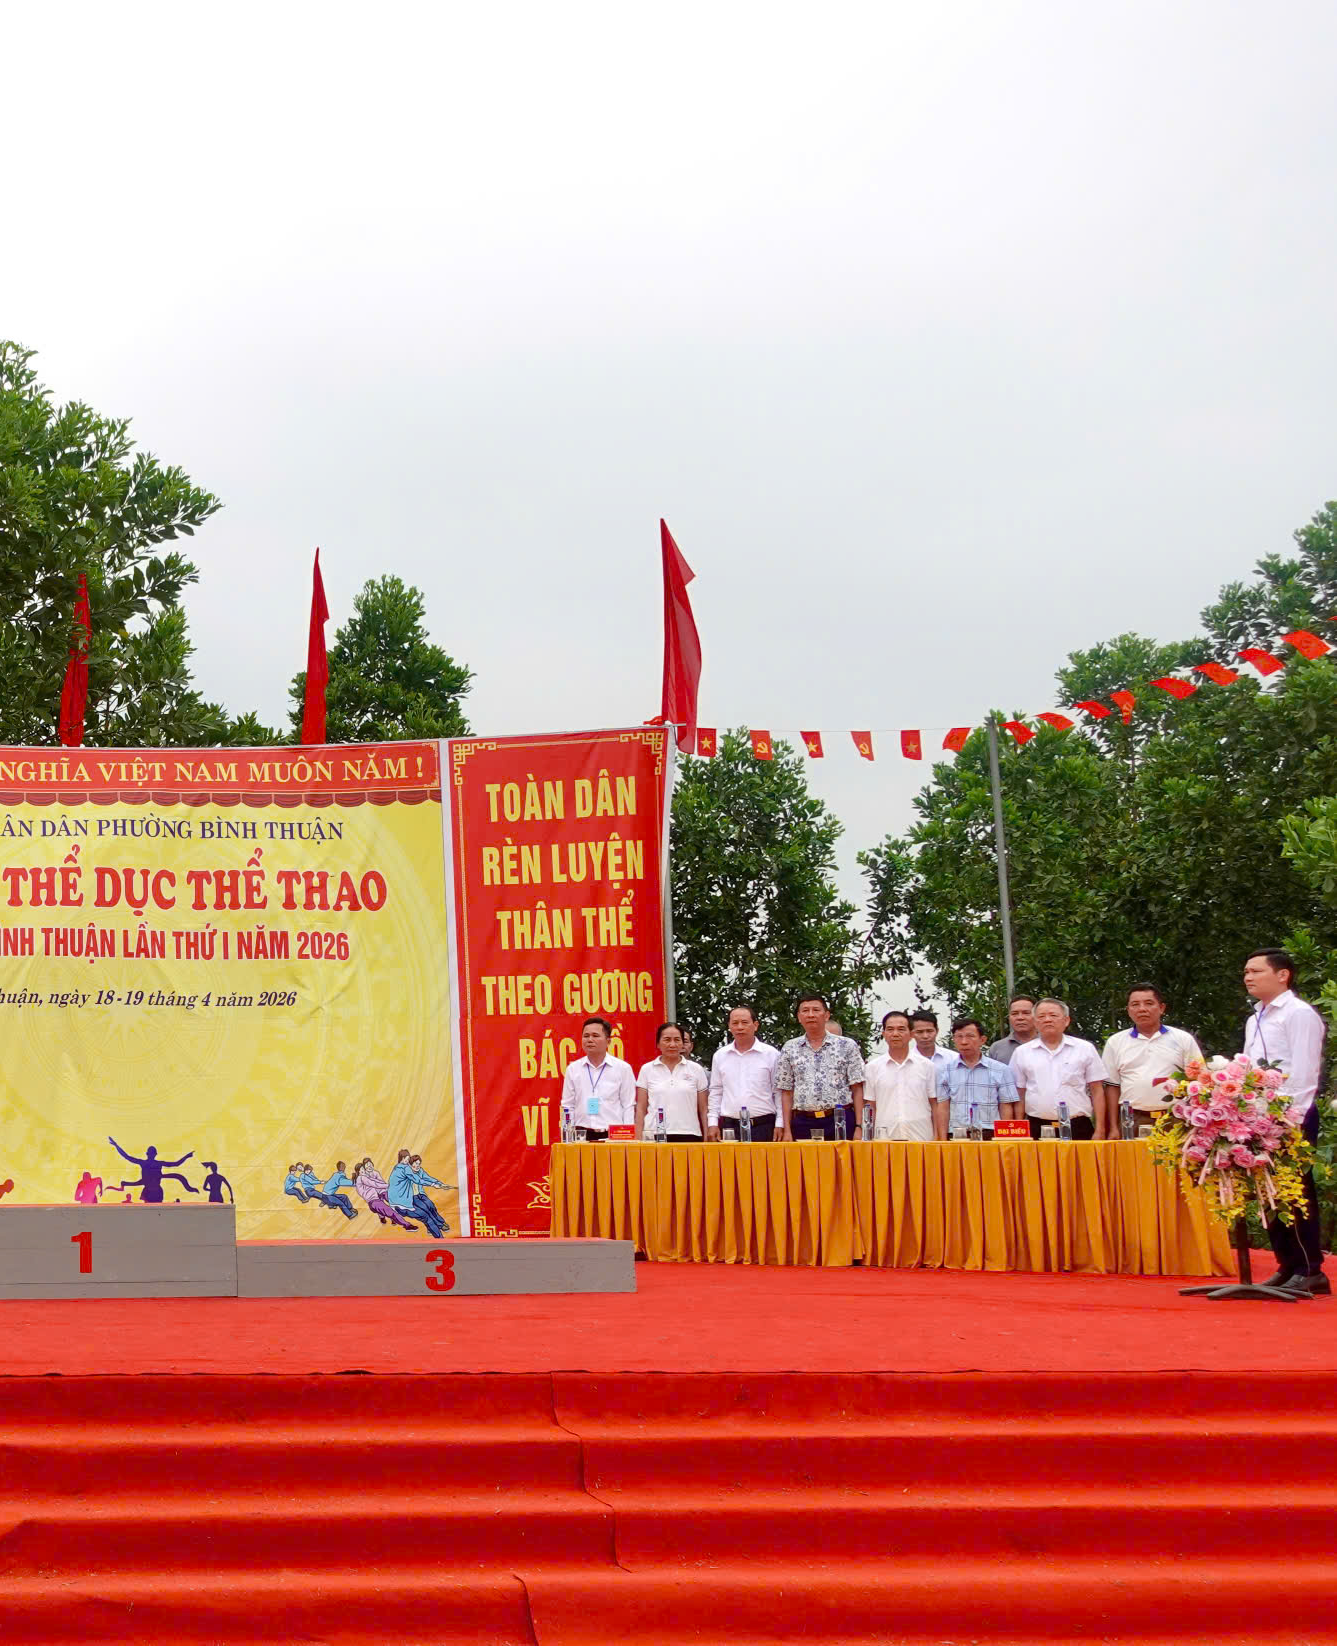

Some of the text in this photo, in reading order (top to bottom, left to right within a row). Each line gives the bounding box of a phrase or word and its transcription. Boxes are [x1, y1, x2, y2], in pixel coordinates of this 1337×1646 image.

[98, 757, 167, 787] VIỆT
[174, 762, 238, 782] NAM
[247, 756, 333, 783] MUÔN
[342, 754, 407, 781] NĂM
[415, 756, 424, 778] !
[485, 768, 637, 823] TOÀN DÂN
[41, 813, 89, 838] DÂN
[96, 812, 193, 839] PHƯỜNG
[199, 815, 257, 839] BÌNH
[264, 816, 344, 845] THUẬN
[2, 843, 84, 907] THỂ
[93, 867, 177, 917] DỤC
[186, 847, 268, 911] THỂ
[276, 870, 387, 912] THAO
[482, 832, 644, 890] RÈN LUYỆN
[41, 922, 115, 964] THUẬN
[122, 919, 166, 959] LẦN
[171, 923, 217, 961] THỨ
[222, 931, 229, 961] I
[237, 925, 290, 960] NĂM
[297, 931, 349, 961] 2026
[496, 886, 634, 950] THÂN THỂ
[47, 988, 89, 1009] ngày
[147, 988, 198, 1010] tháng
[201, 991, 212, 1007] 4
[215, 991, 253, 1007] năm
[257, 991, 298, 1007] 2026
[481, 968, 653, 1016] THEO GƯƠNG
[519, 1029, 577, 1079] BÁC
[521, 1097, 551, 1146] VĨ
[70, 1231, 94, 1274] 1
[424, 1249, 457, 1293] 3
